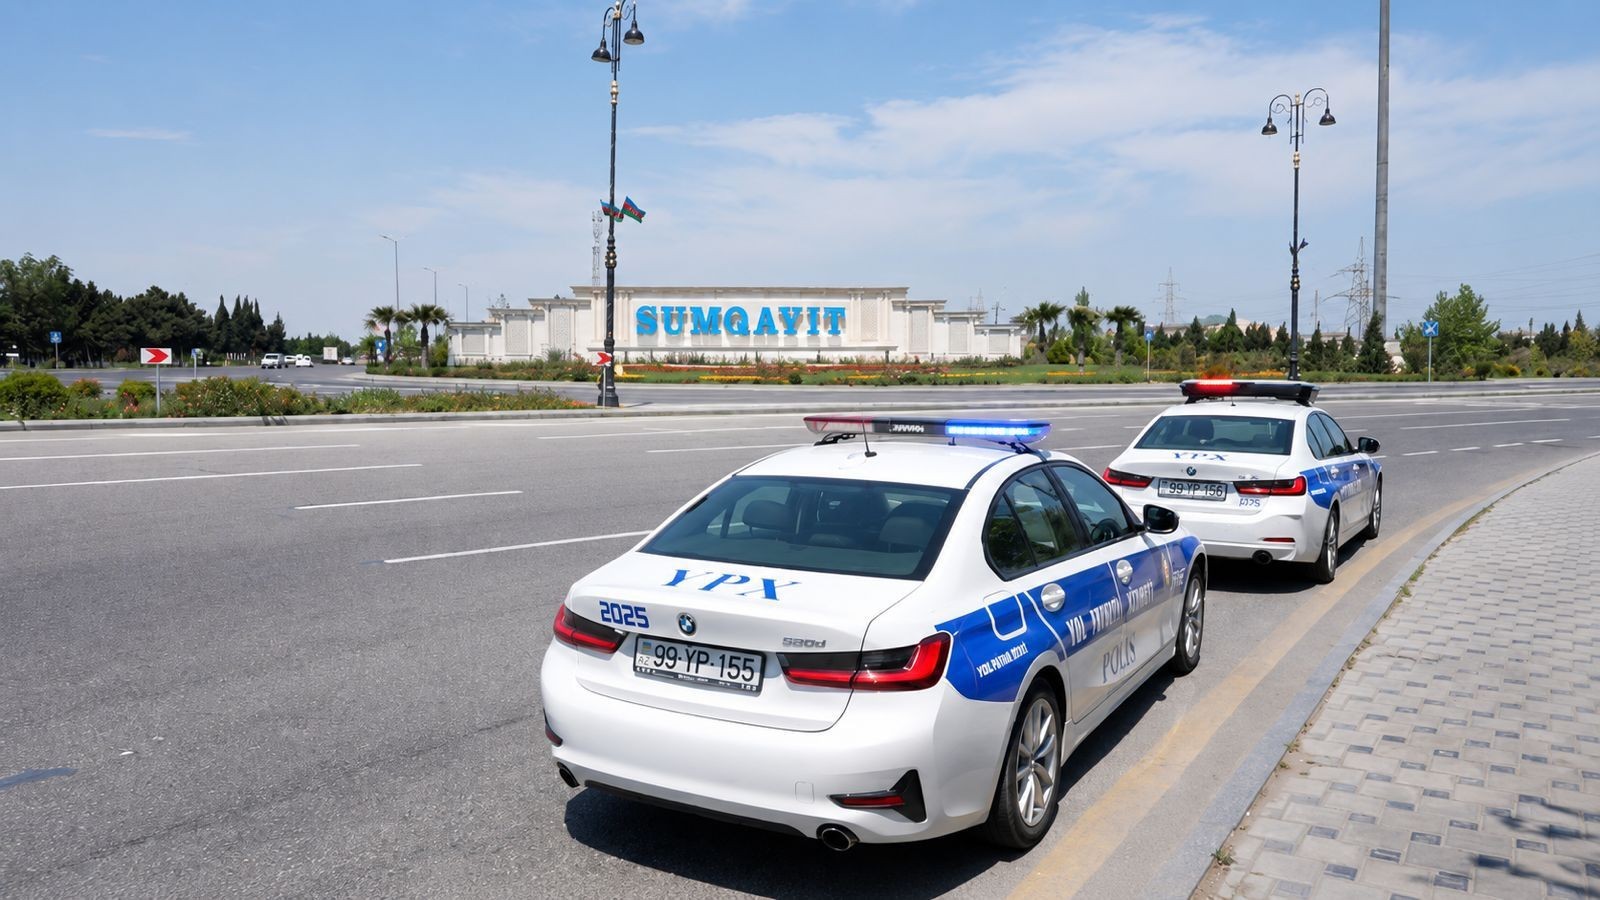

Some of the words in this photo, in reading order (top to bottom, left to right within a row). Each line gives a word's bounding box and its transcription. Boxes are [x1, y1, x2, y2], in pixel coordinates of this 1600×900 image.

[635, 305, 846, 336] SUMQAYIT
[1169, 482, 1184, 494] 99
[1187, 484, 1200, 495] YP
[1204, 485, 1223, 497] 156
[661, 569, 801, 601] YPX
[599, 600, 650, 629] 2025
